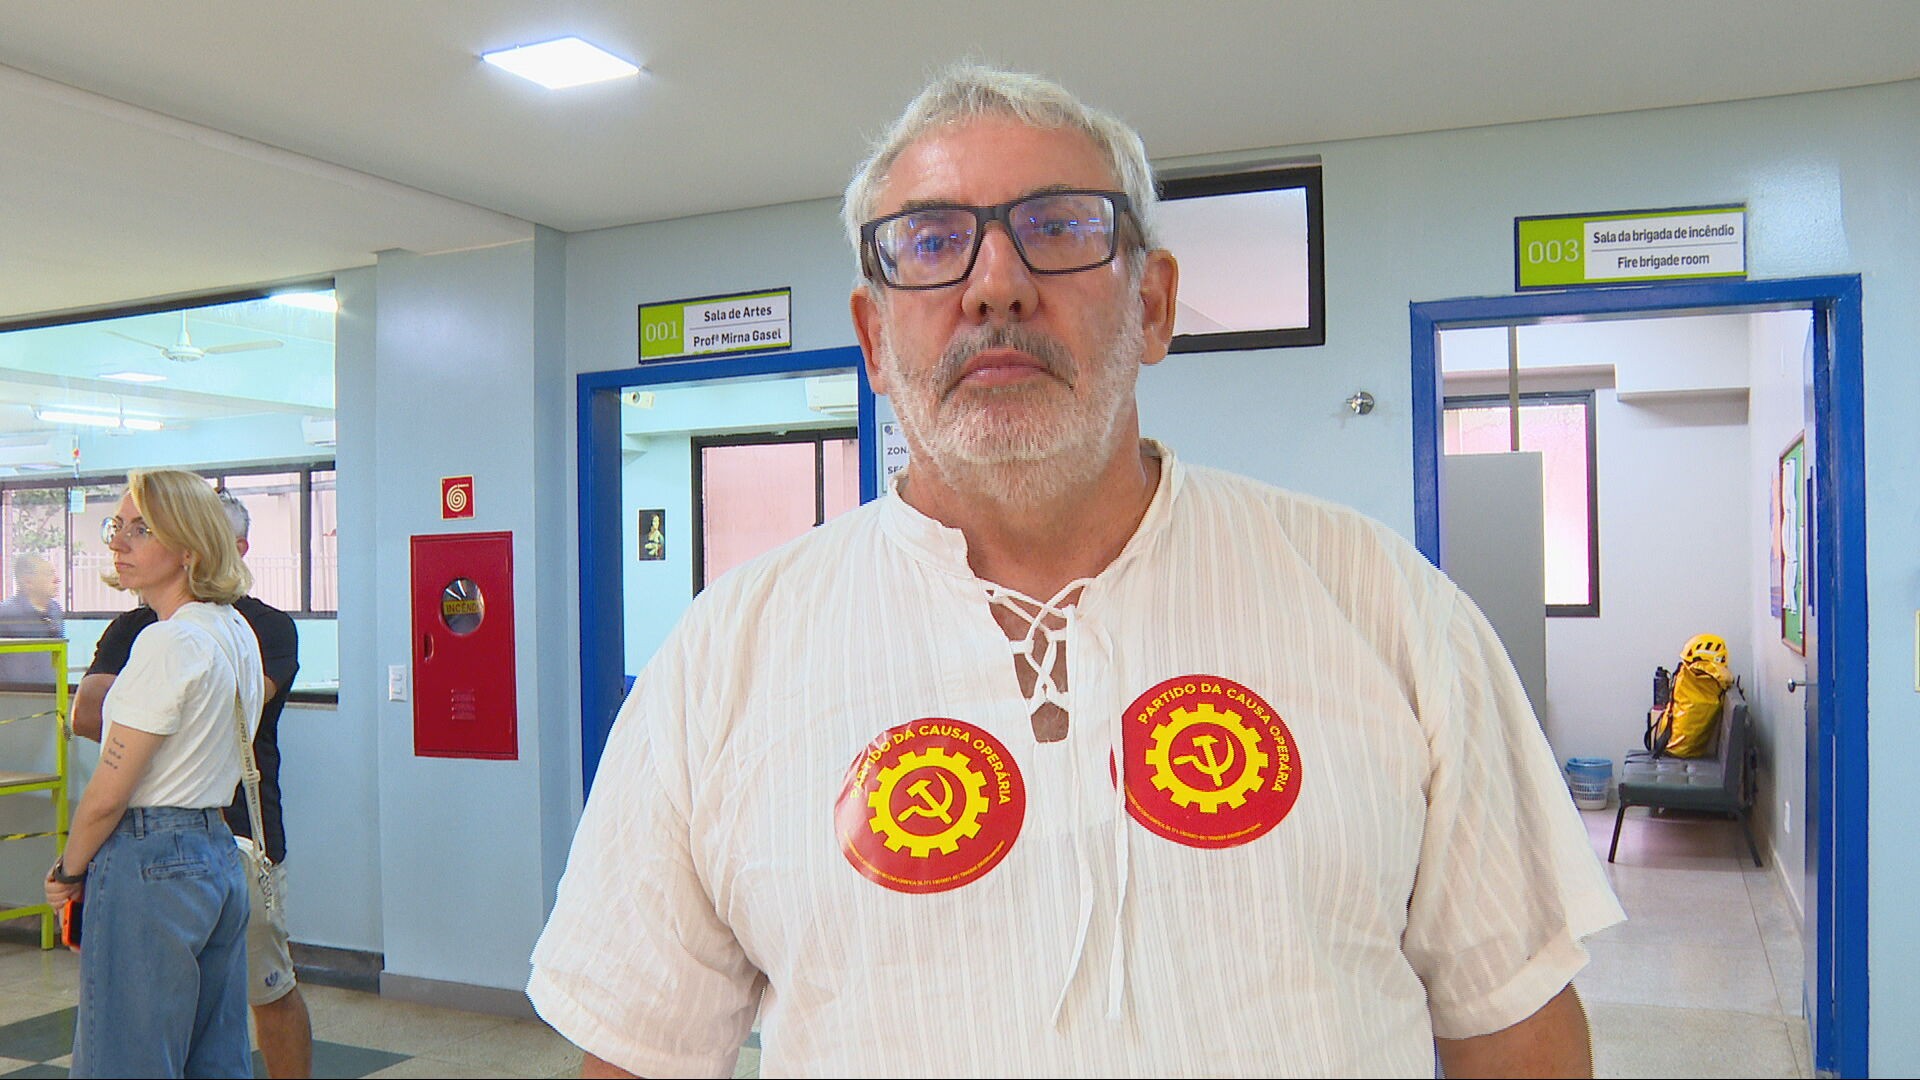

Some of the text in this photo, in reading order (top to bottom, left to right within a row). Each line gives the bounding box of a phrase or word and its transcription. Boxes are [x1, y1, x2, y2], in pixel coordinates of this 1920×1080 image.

[1593, 224, 1735, 244] Sala da brigada de incêndio
[1527, 239, 1580, 264] 003
[1617, 254, 1710, 270] Fire brigade room
[704, 306, 772, 322] Sala de Artes
[645, 320, 679, 343] 001
[721, 331, 750, 344] Mirna
[752, 328, 782, 341] Gasel
[887, 446, 909, 456] ZON
[1137, 683, 1293, 793] PARTIDO DA CAUSA OPERÁRIA
[893, 728, 916, 746] DA
[918, 725, 971, 743] CAUSA
[972, 739, 1011, 805] OPERÁRIA
